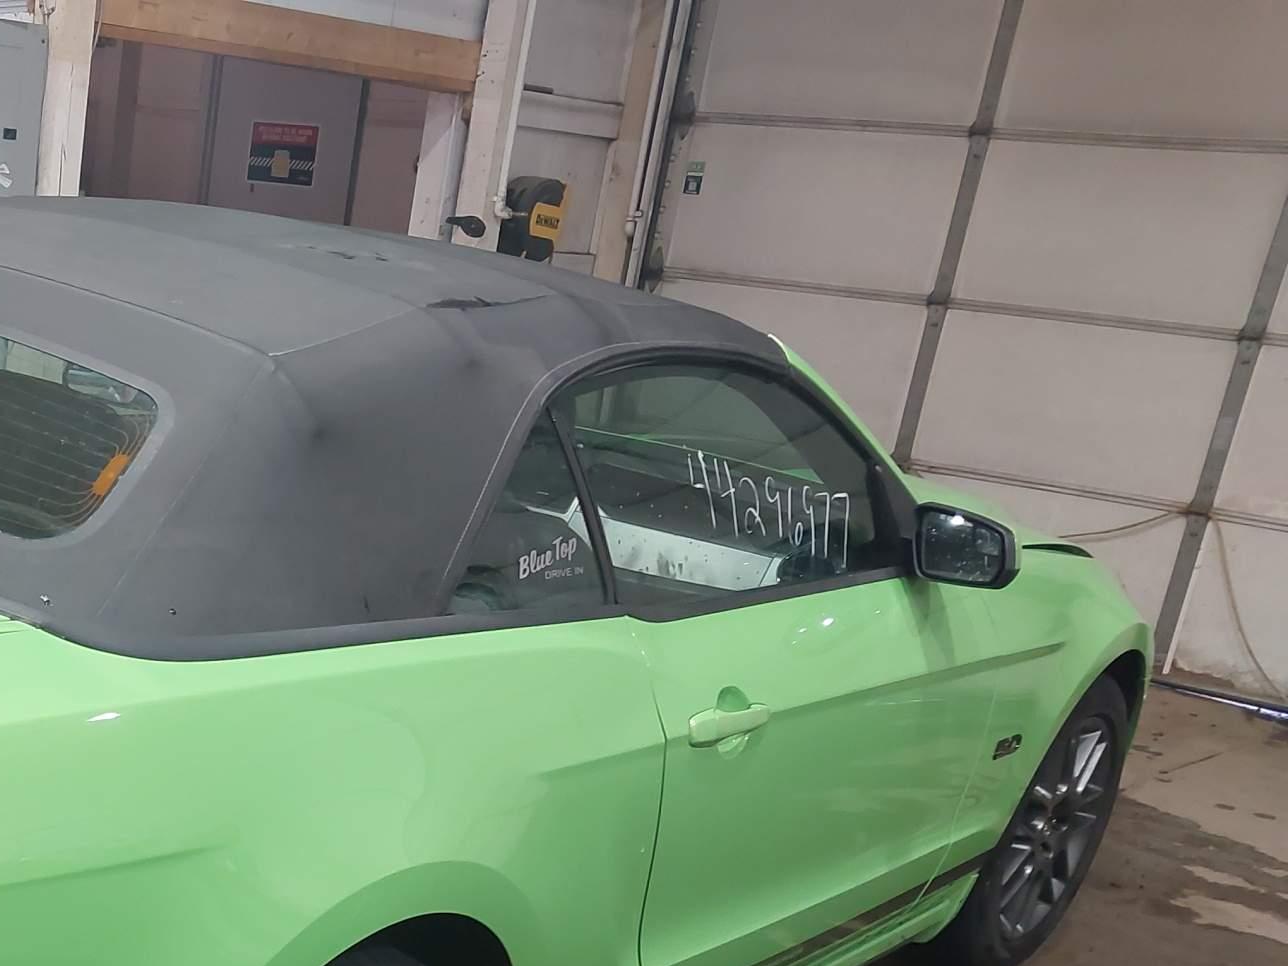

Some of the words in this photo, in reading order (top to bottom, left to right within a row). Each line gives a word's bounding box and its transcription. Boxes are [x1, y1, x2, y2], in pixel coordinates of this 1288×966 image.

[687, 450, 850, 569] 44296977
[518, 549, 554, 580] Blue
[552, 536, 577, 561] Top
[544, 567, 572, 580] DRIVE
[574, 566, 585, 576] IN
